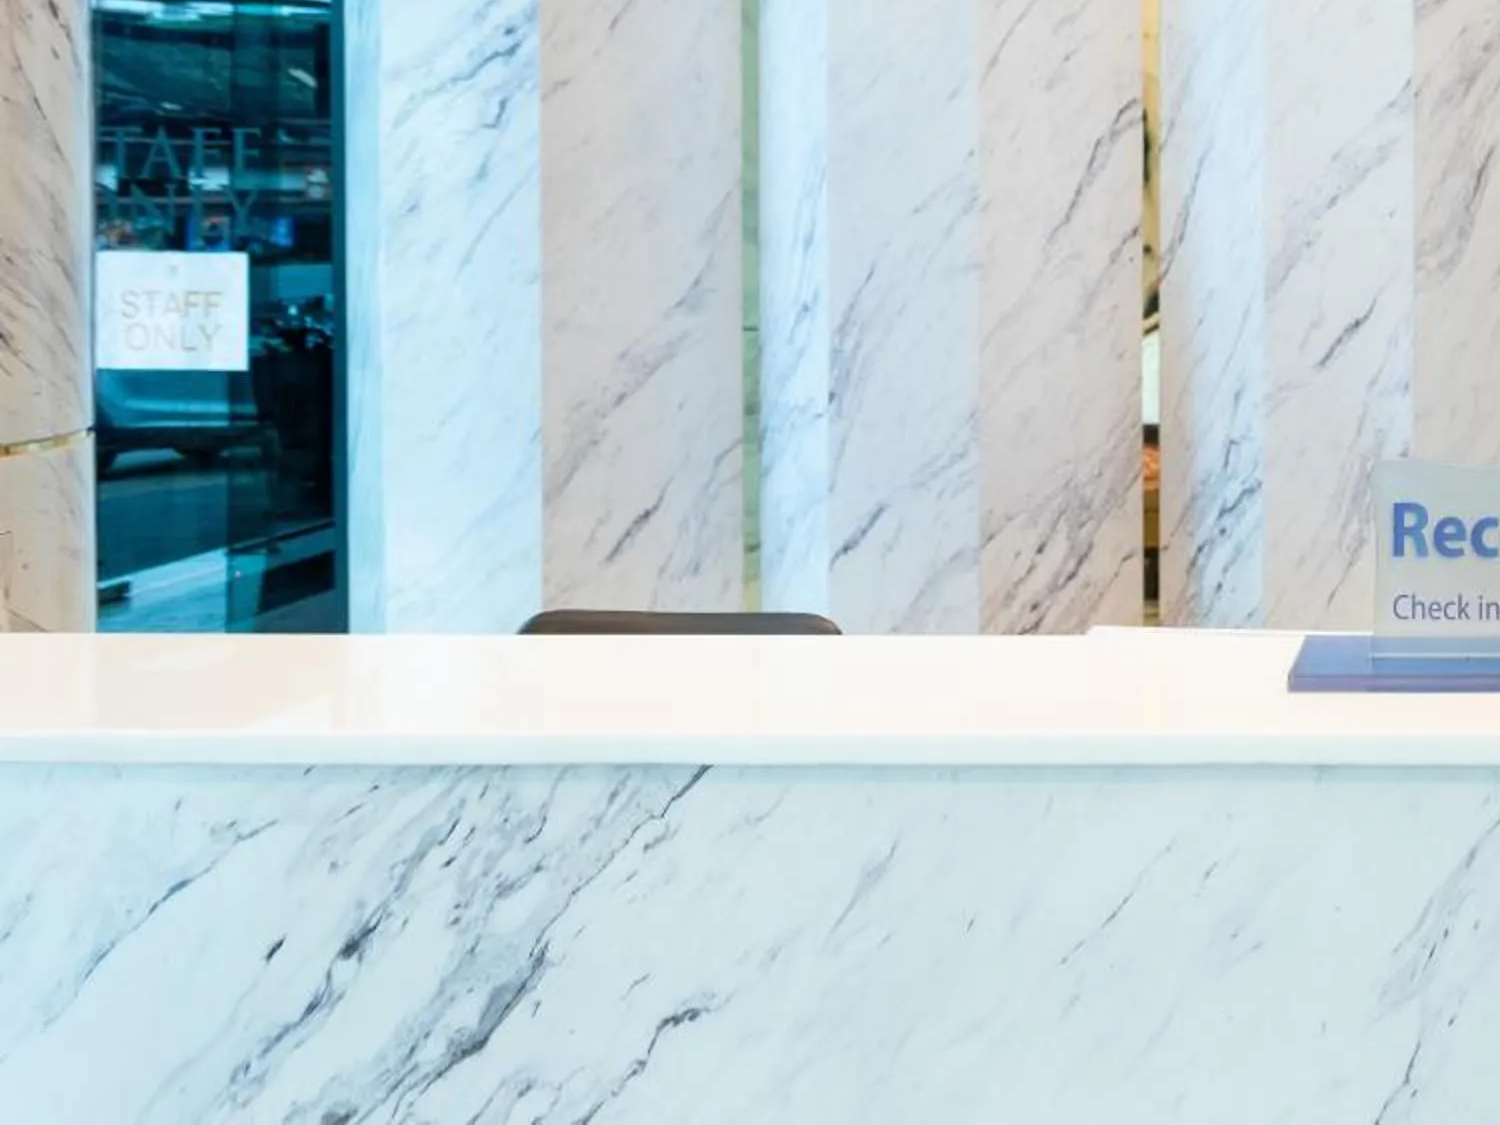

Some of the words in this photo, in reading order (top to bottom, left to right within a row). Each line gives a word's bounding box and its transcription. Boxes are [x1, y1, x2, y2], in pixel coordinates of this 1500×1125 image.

[120, 290, 224, 320] STAFF
[124, 324, 221, 352] ONLY
[1392, 594, 1470, 621] Check
[1478, 595, 1500, 621] in
